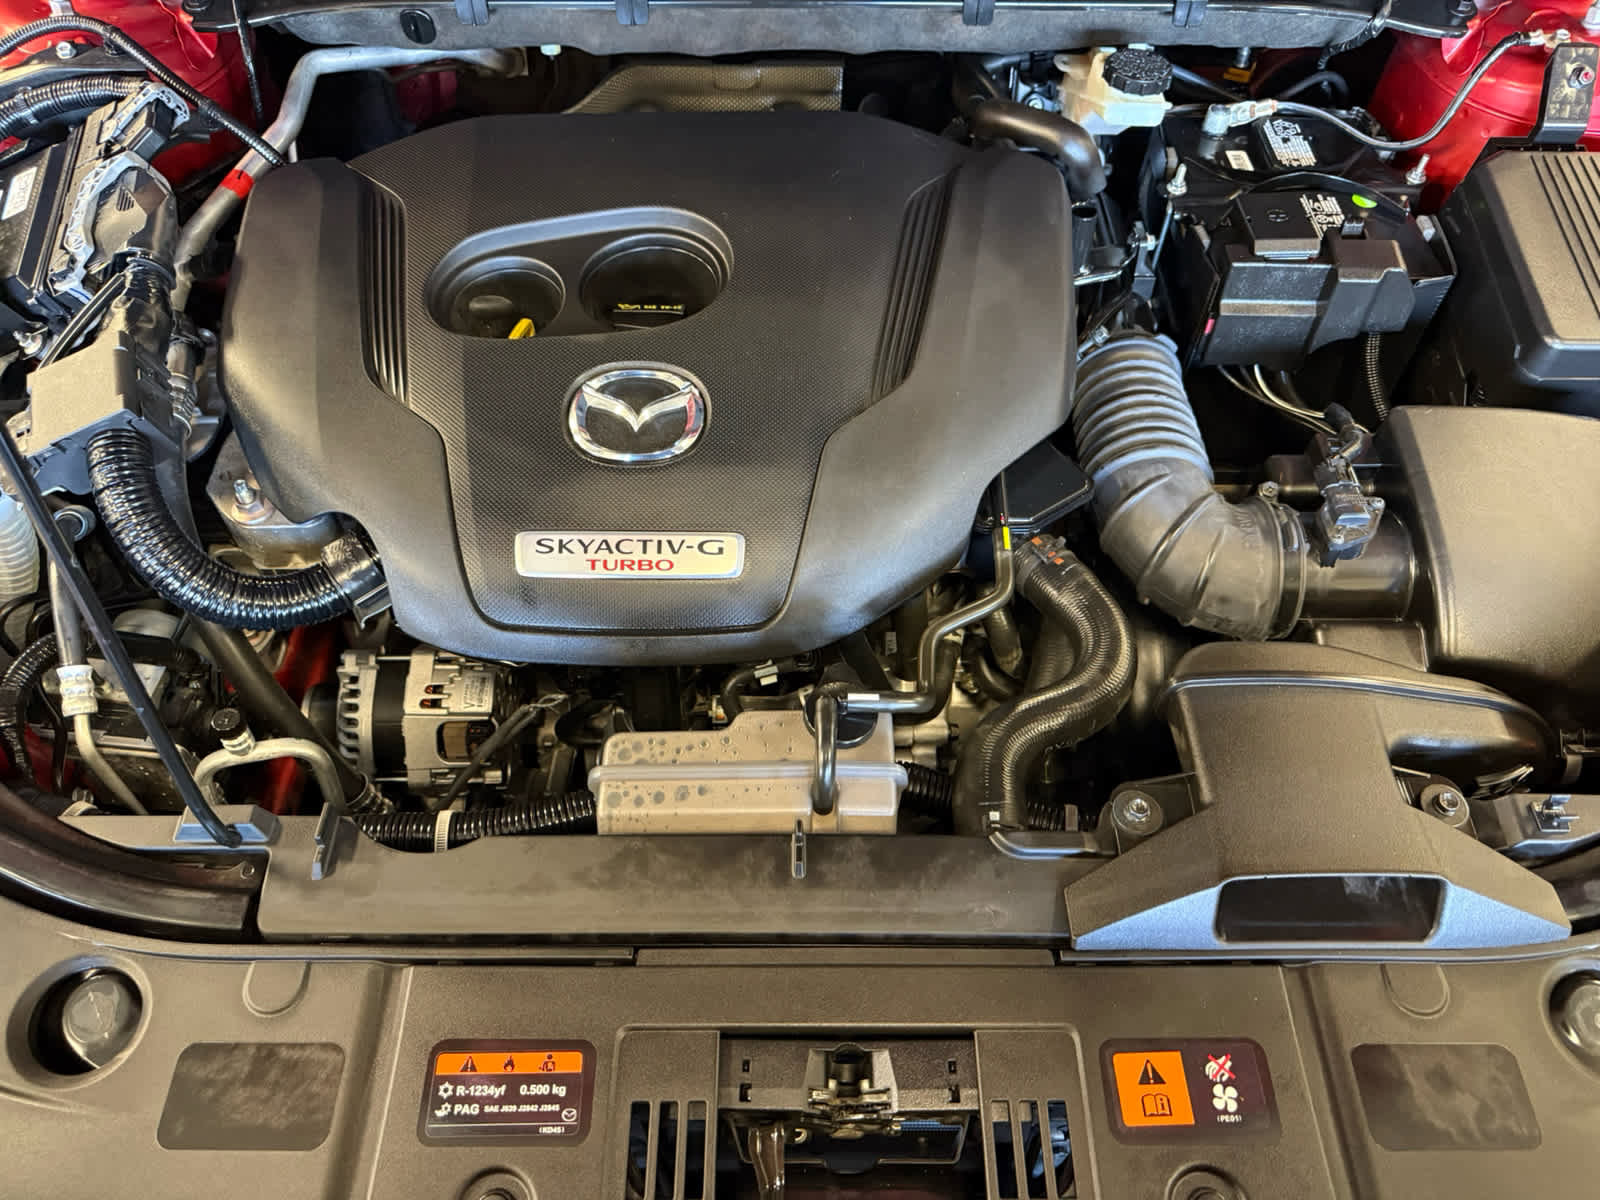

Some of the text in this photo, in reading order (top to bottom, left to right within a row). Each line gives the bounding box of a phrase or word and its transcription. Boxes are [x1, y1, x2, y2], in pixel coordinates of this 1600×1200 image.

[535, 538, 724, 555] SKYACTIV-G
[586, 559, 674, 571] TURBO
[455, 1083, 567, 1098] R-1234yf 0.500 kg
[453, 1103, 480, 1115] PAG
